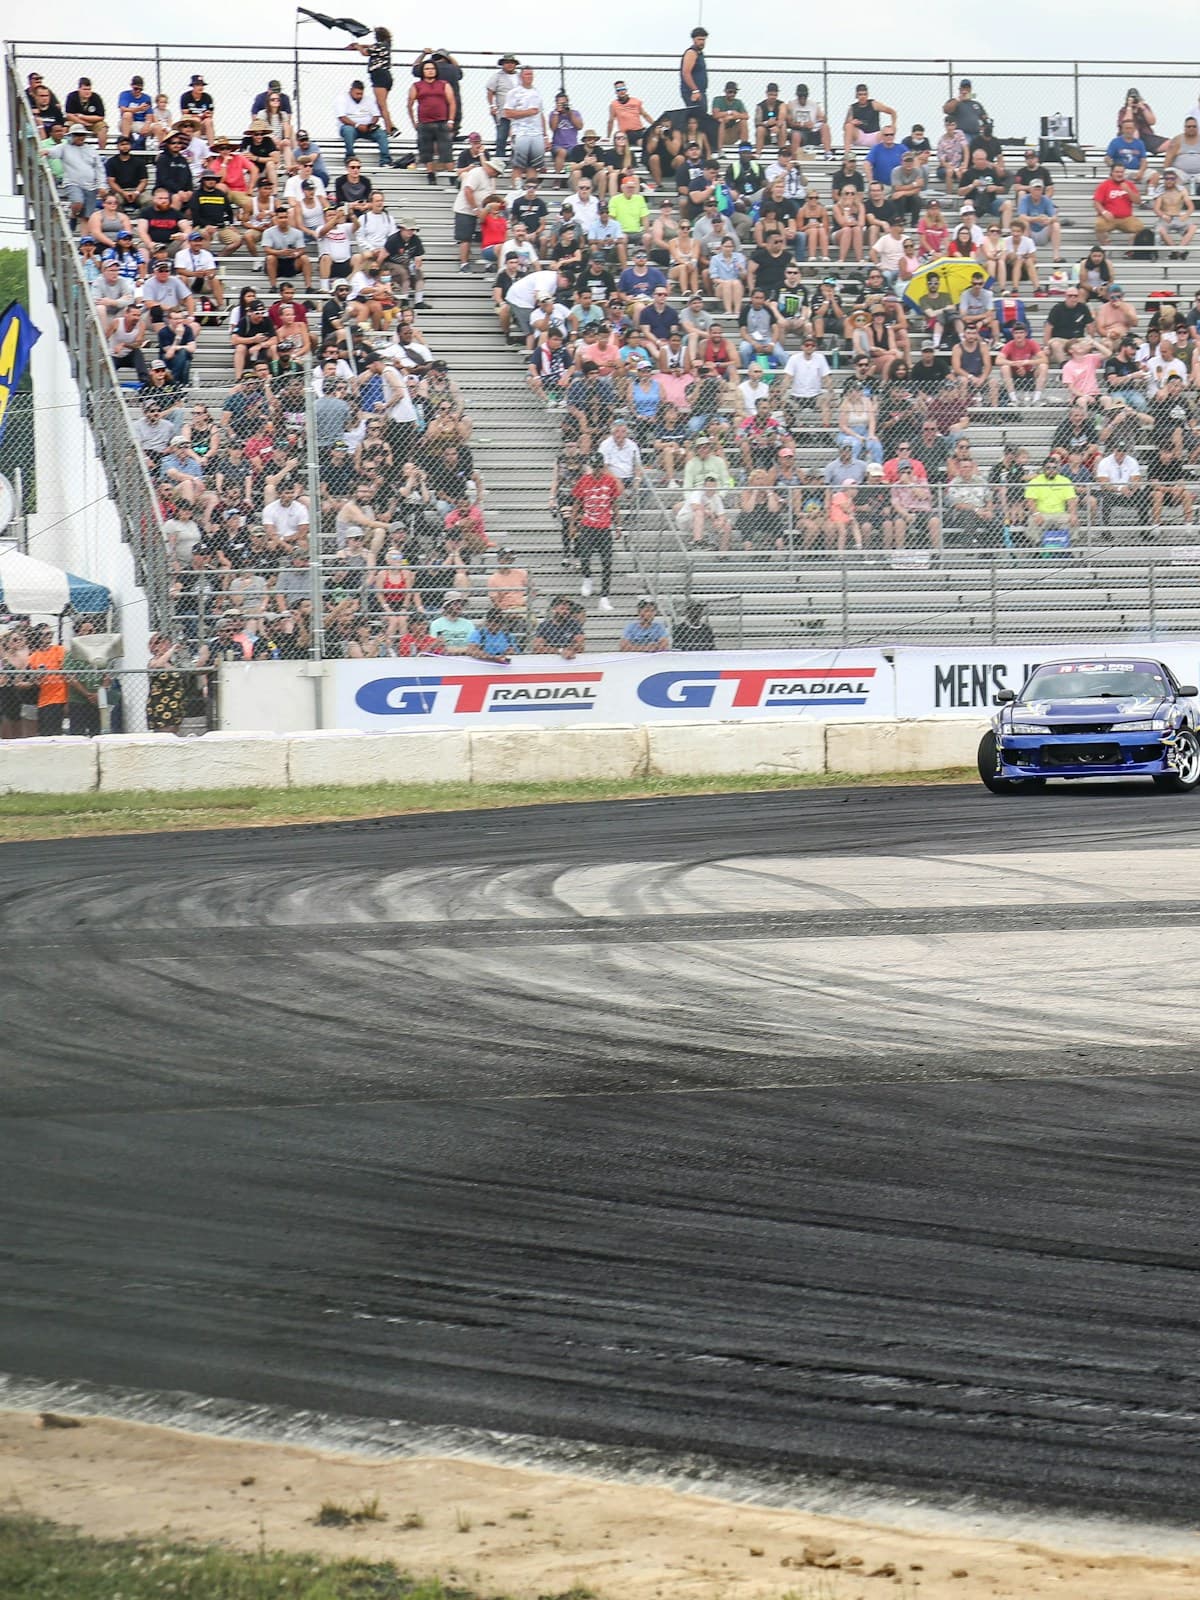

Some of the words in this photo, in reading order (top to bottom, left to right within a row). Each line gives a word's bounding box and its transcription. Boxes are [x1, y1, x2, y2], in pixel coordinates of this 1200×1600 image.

[355, 673, 500, 715] GT
[492, 687, 597, 701] RADIAL
[637, 669, 773, 708] GT
[769, 682, 870, 696] RADIAL
[934, 664, 1008, 708] MEN'S
